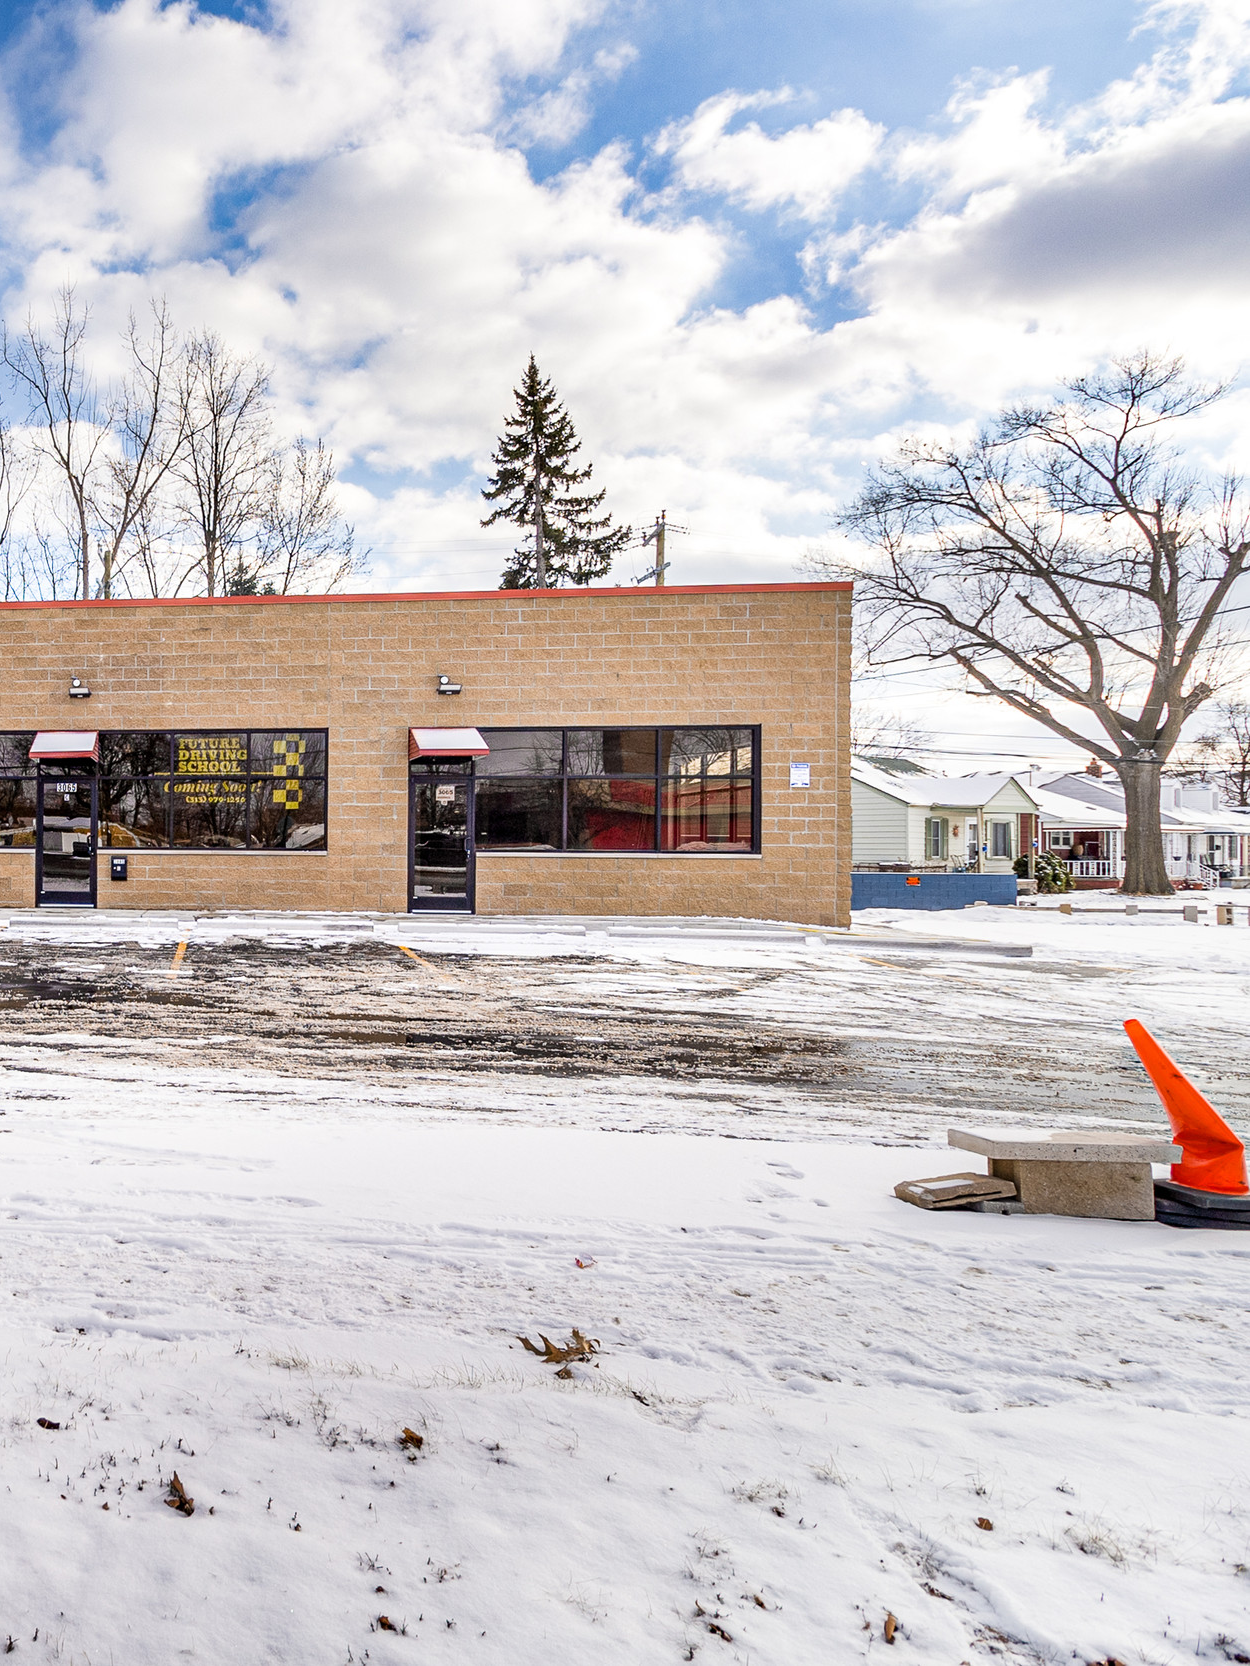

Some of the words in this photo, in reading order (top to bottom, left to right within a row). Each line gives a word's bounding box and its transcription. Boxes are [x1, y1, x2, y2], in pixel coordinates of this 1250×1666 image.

[178, 738, 240, 749] FUTURE
[178, 749, 247, 760] DRIVING
[178, 761, 241, 772] SCHOOL
[58, 783, 76, 792] 3065
